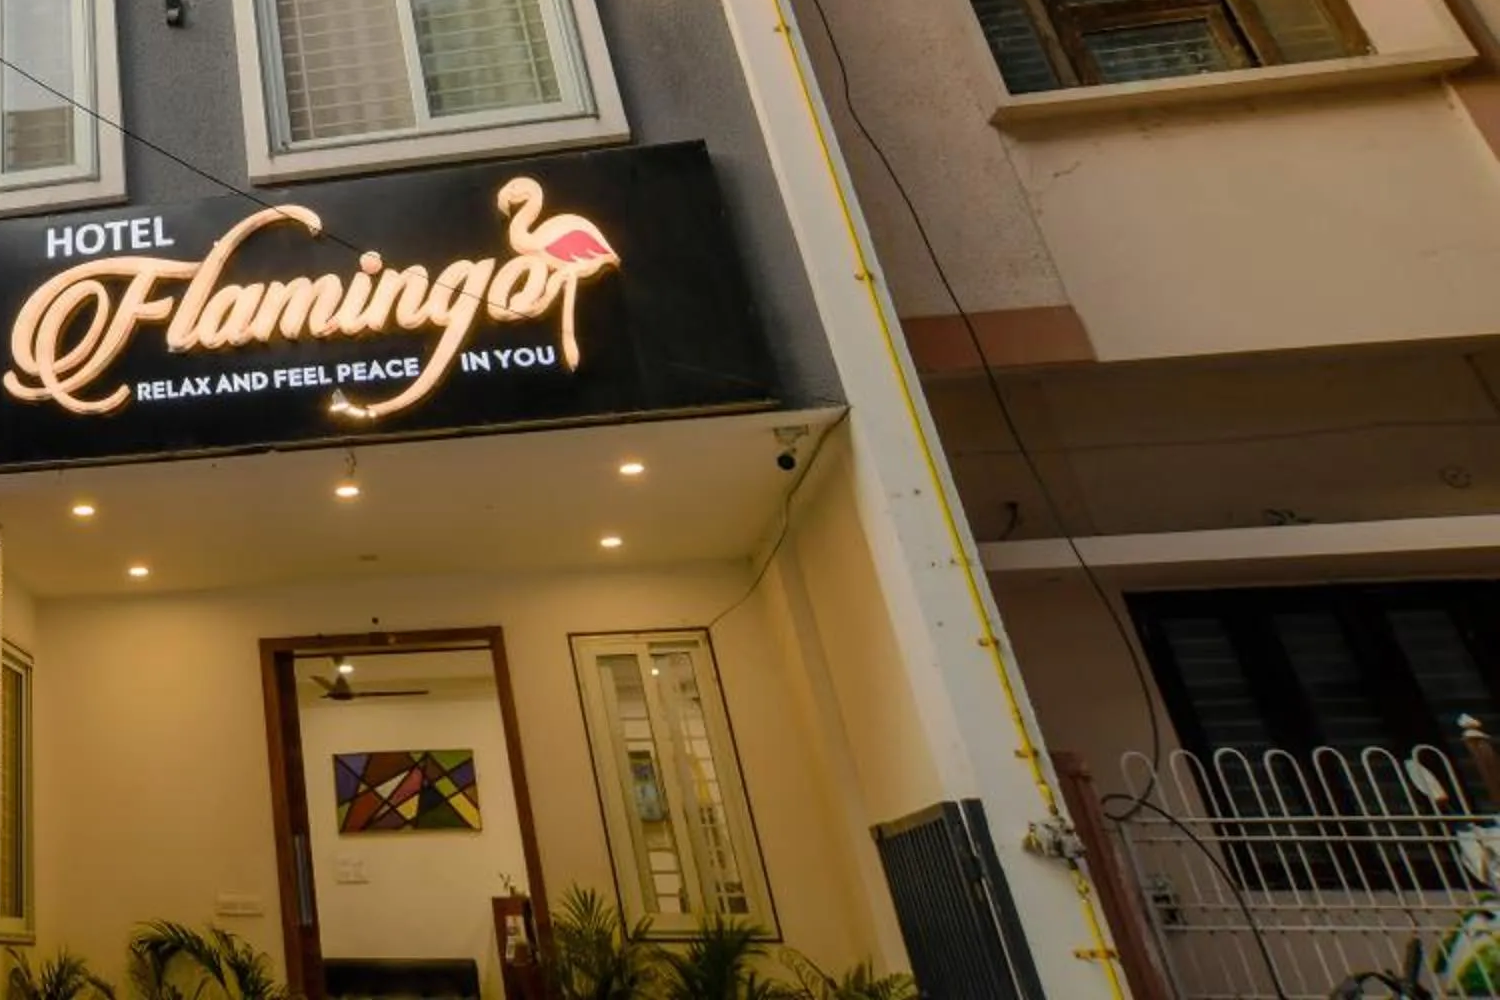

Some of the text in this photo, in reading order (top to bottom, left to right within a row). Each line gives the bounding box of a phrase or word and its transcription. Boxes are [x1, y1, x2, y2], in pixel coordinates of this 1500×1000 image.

[46, 215, 175, 259] HOTEL
[3, 203, 560, 420] Flamingo
[136, 345, 556, 401] RELAX AND FEEL PEACE IN YOU
